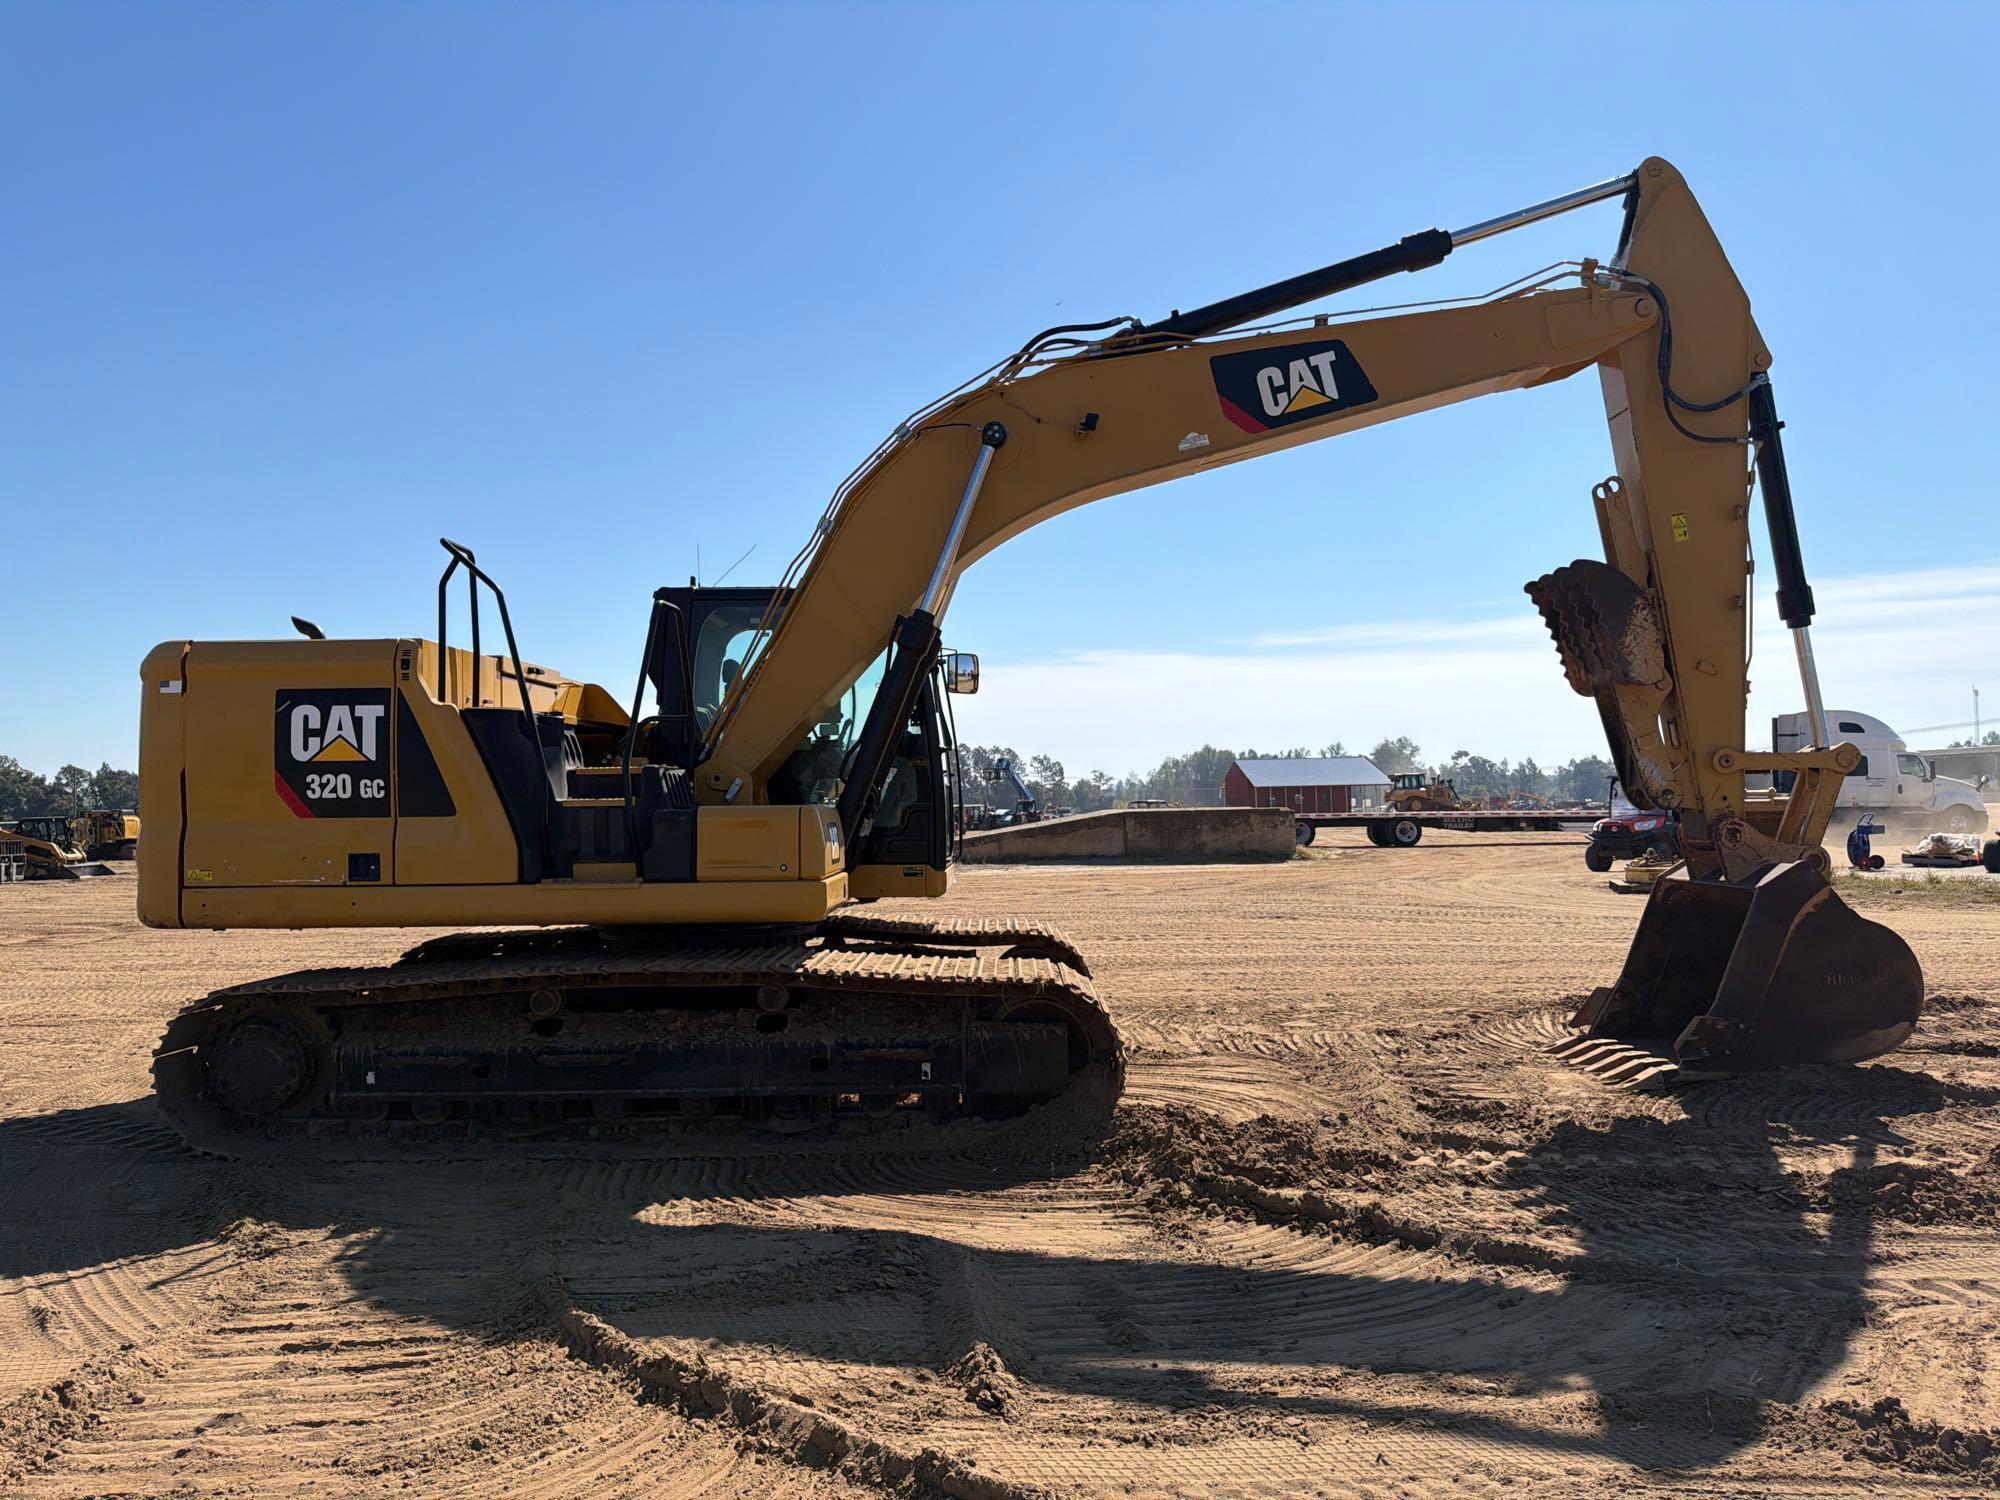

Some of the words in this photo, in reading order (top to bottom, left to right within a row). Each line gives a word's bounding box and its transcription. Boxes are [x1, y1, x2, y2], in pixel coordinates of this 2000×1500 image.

[1256, 350, 1339, 417] CAT
[290, 704, 385, 761] CAT
[305, 773, 352, 799] 320
[359, 778, 385, 799] GC
